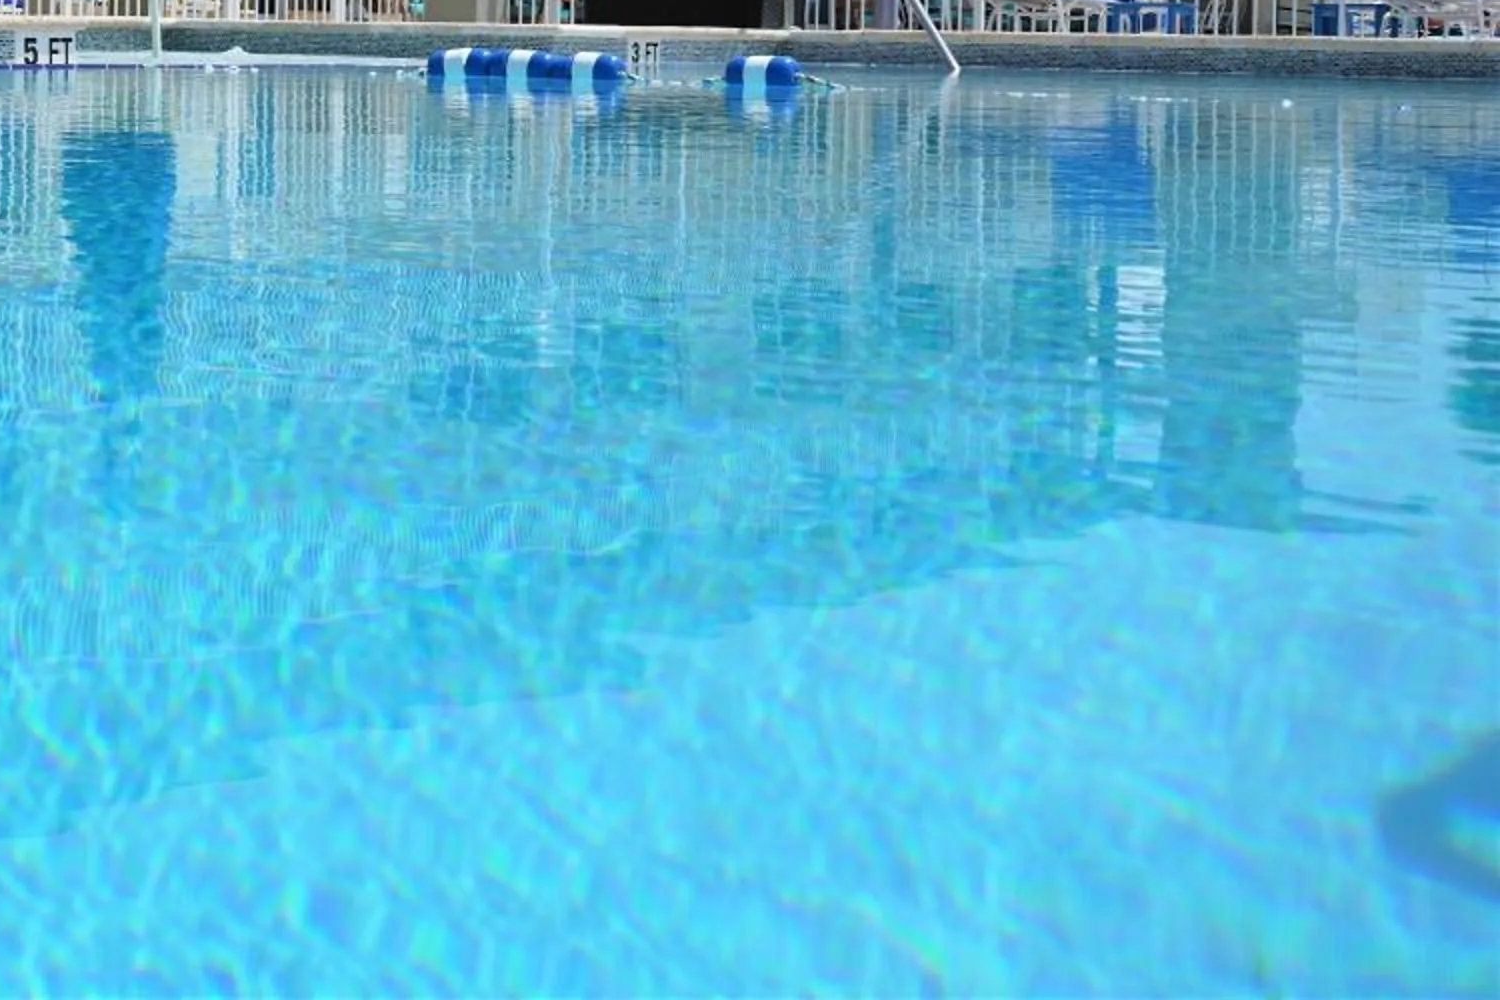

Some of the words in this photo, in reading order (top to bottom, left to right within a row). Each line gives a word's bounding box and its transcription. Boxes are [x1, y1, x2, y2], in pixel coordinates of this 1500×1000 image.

[24, 37, 39, 65] 5
[49, 37, 73, 65] FT
[631, 42, 640, 63] 3
[645, 42, 658, 63] FT
